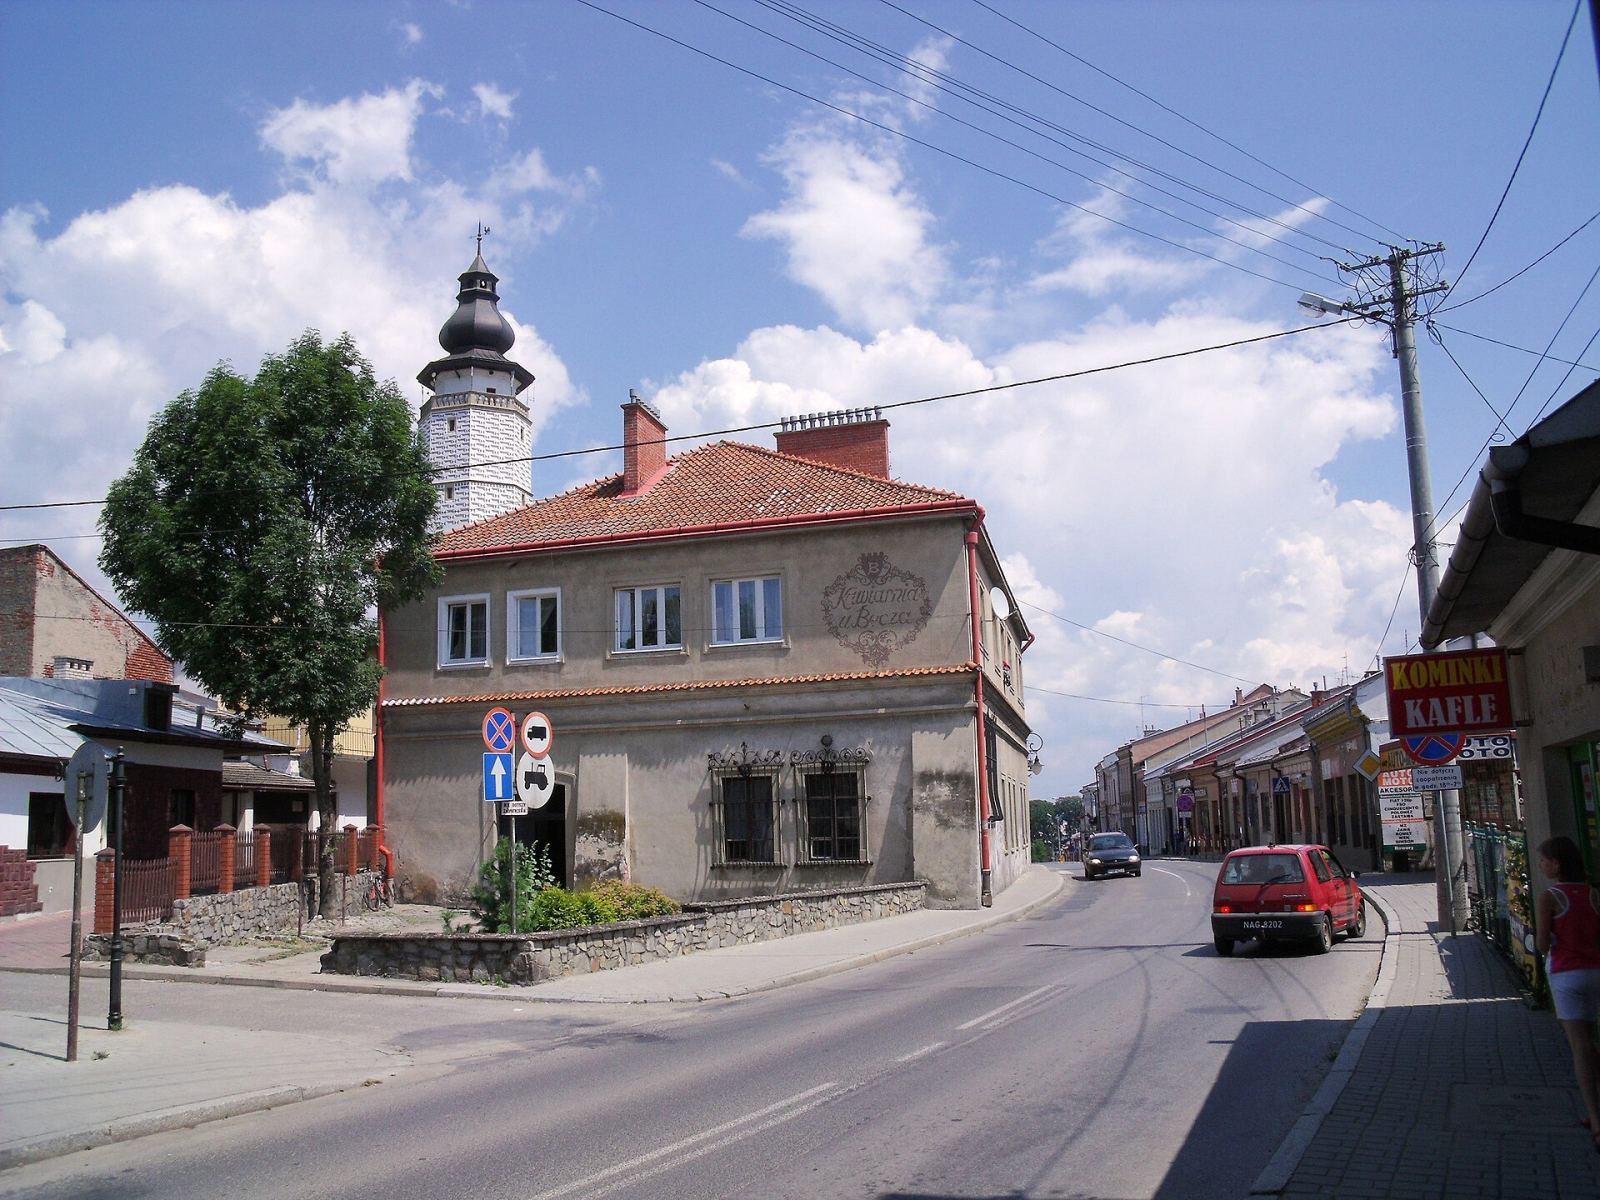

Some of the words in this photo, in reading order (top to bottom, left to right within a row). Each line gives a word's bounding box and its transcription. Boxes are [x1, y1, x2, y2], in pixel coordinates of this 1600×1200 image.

[1390, 655, 1504, 690] KOMINKI
[1404, 693, 1498, 729] KAFLE
[1463, 736, 1509, 748] UTO
[1459, 747, 1510, 759] OTO
[1380, 786, 1413, 794] AKCESOR
[1243, 921, 1260, 929] NAG
[1263, 920, 1283, 929] 8202
